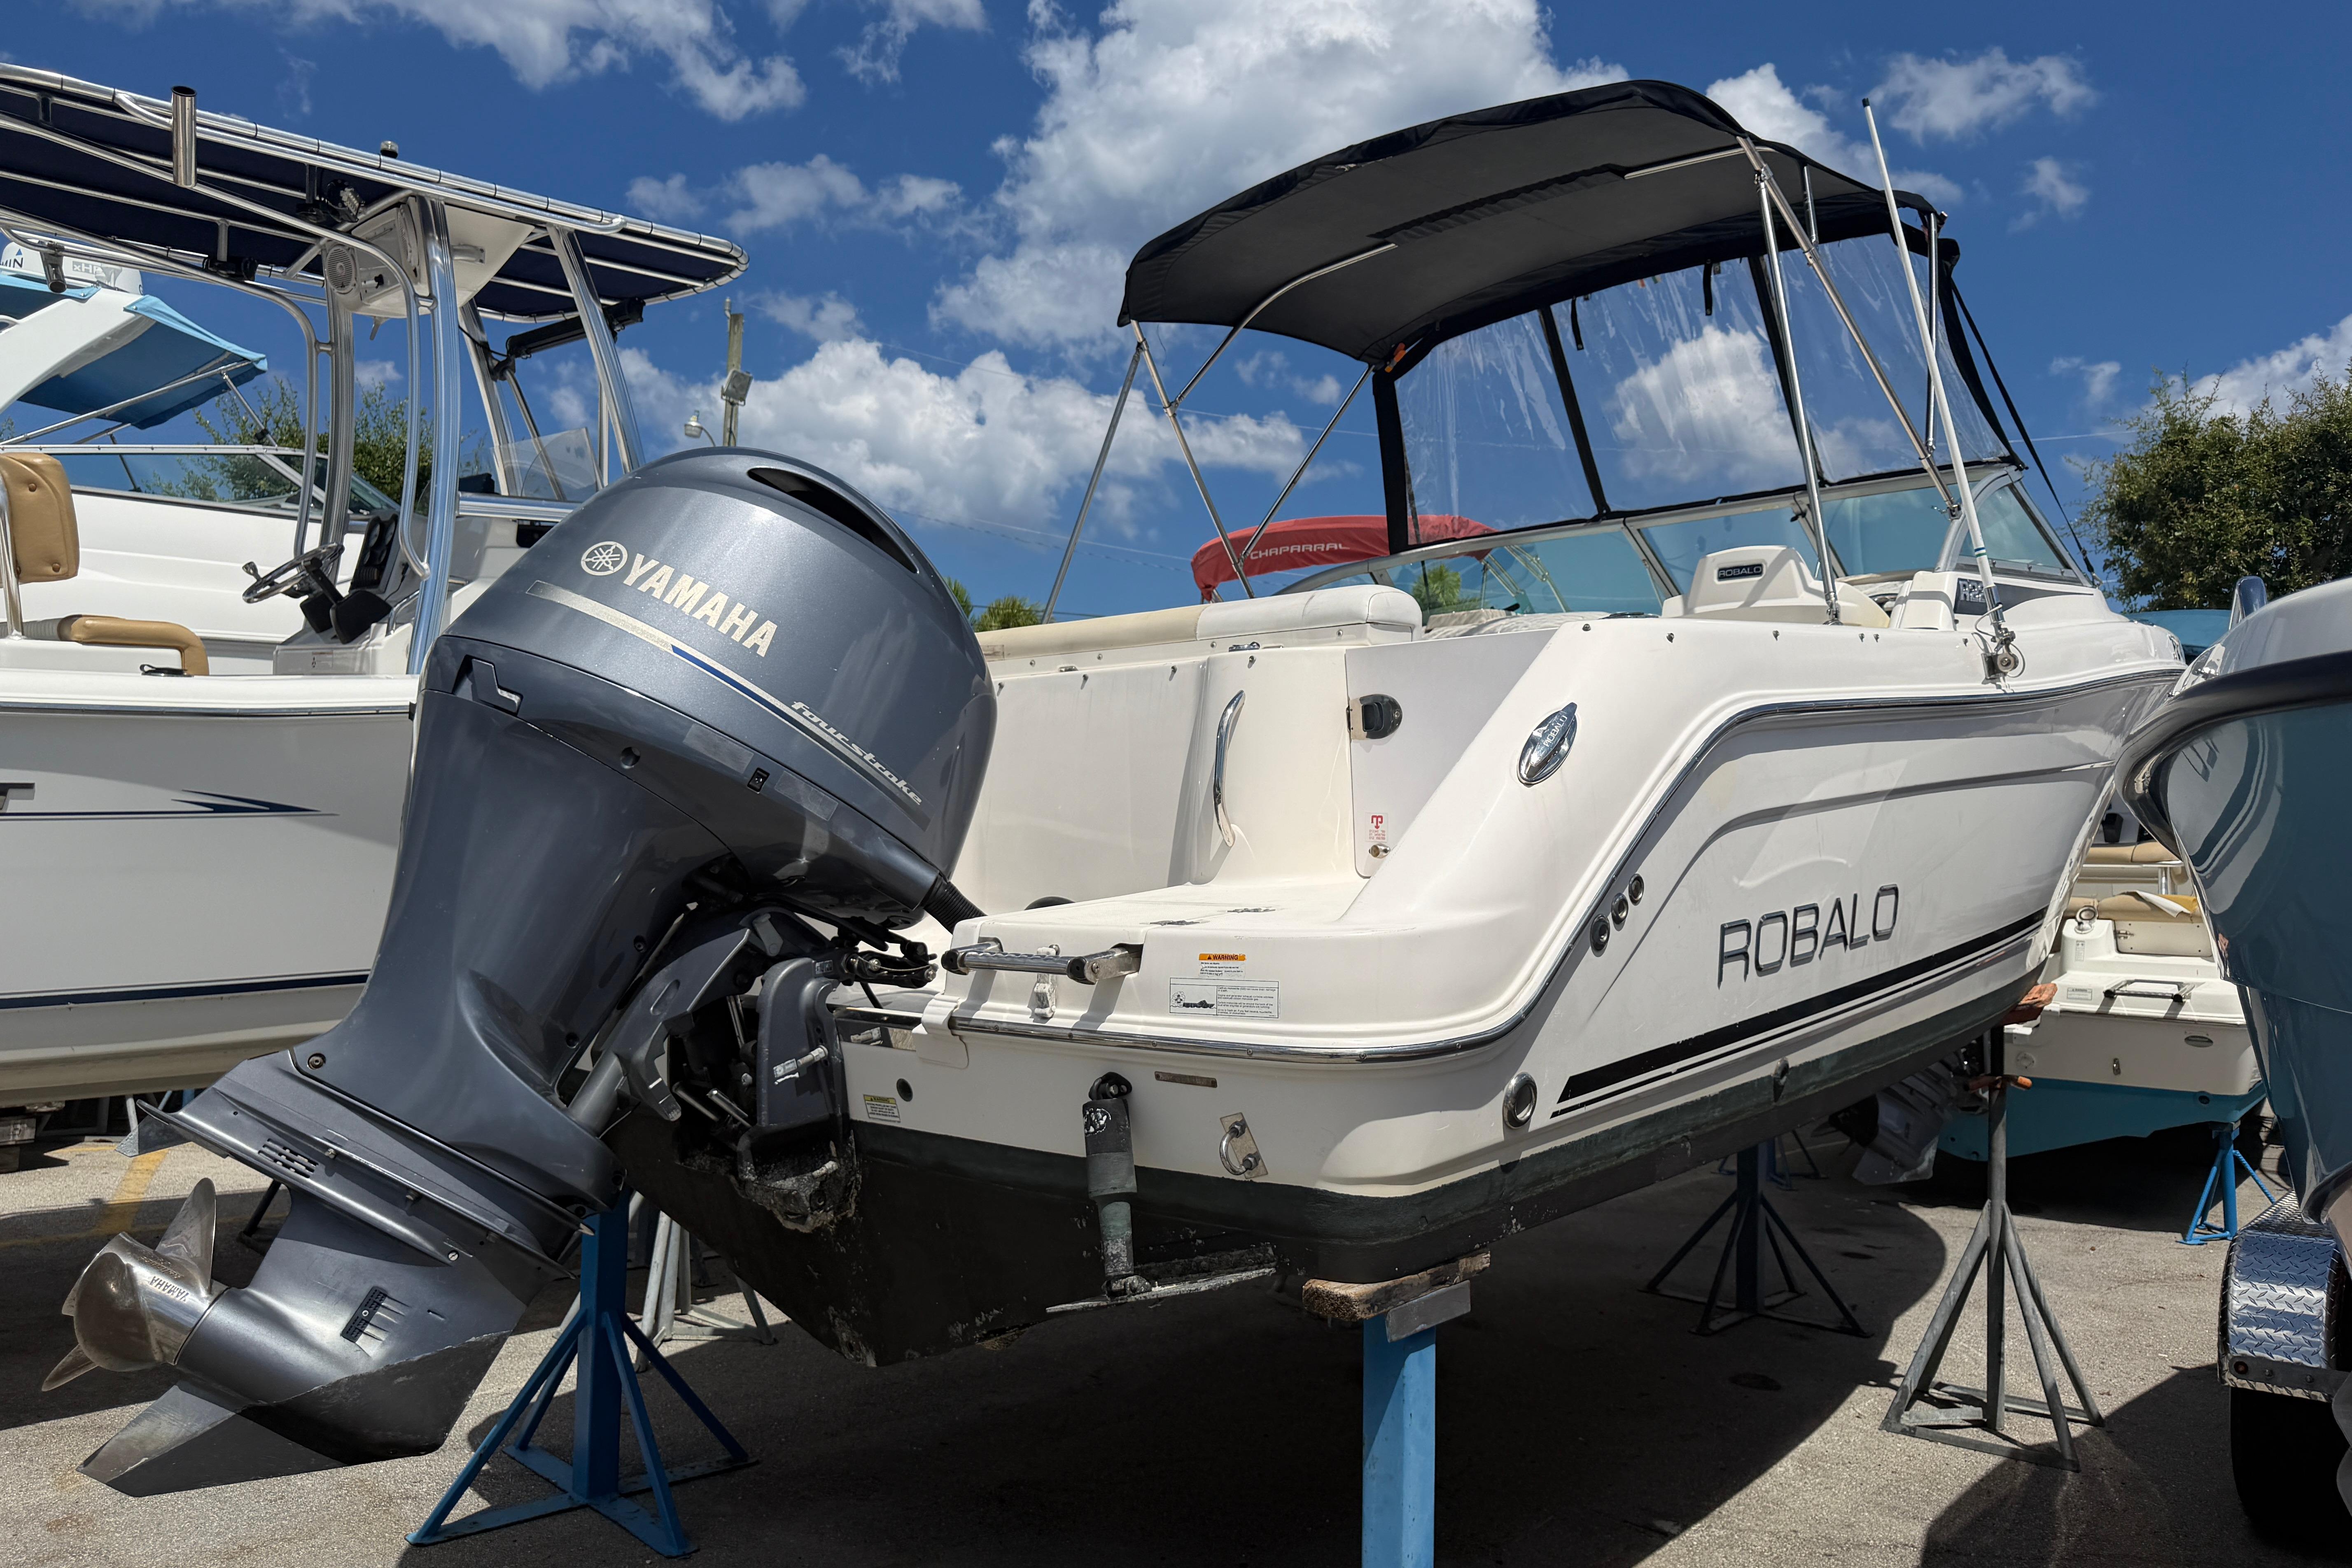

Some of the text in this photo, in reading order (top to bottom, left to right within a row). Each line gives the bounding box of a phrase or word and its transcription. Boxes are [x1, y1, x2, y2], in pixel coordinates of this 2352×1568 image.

[1250, 543, 1351, 560] CHAPARRAL
[1719, 566, 1762, 577] ROBALO
[623, 553, 778, 657] YAMAHA
[1543, 715, 1568, 747] ROBALO
[1717, 884, 1899, 989] ROBALO
[149, 1276, 189, 1302] YAMAHA
